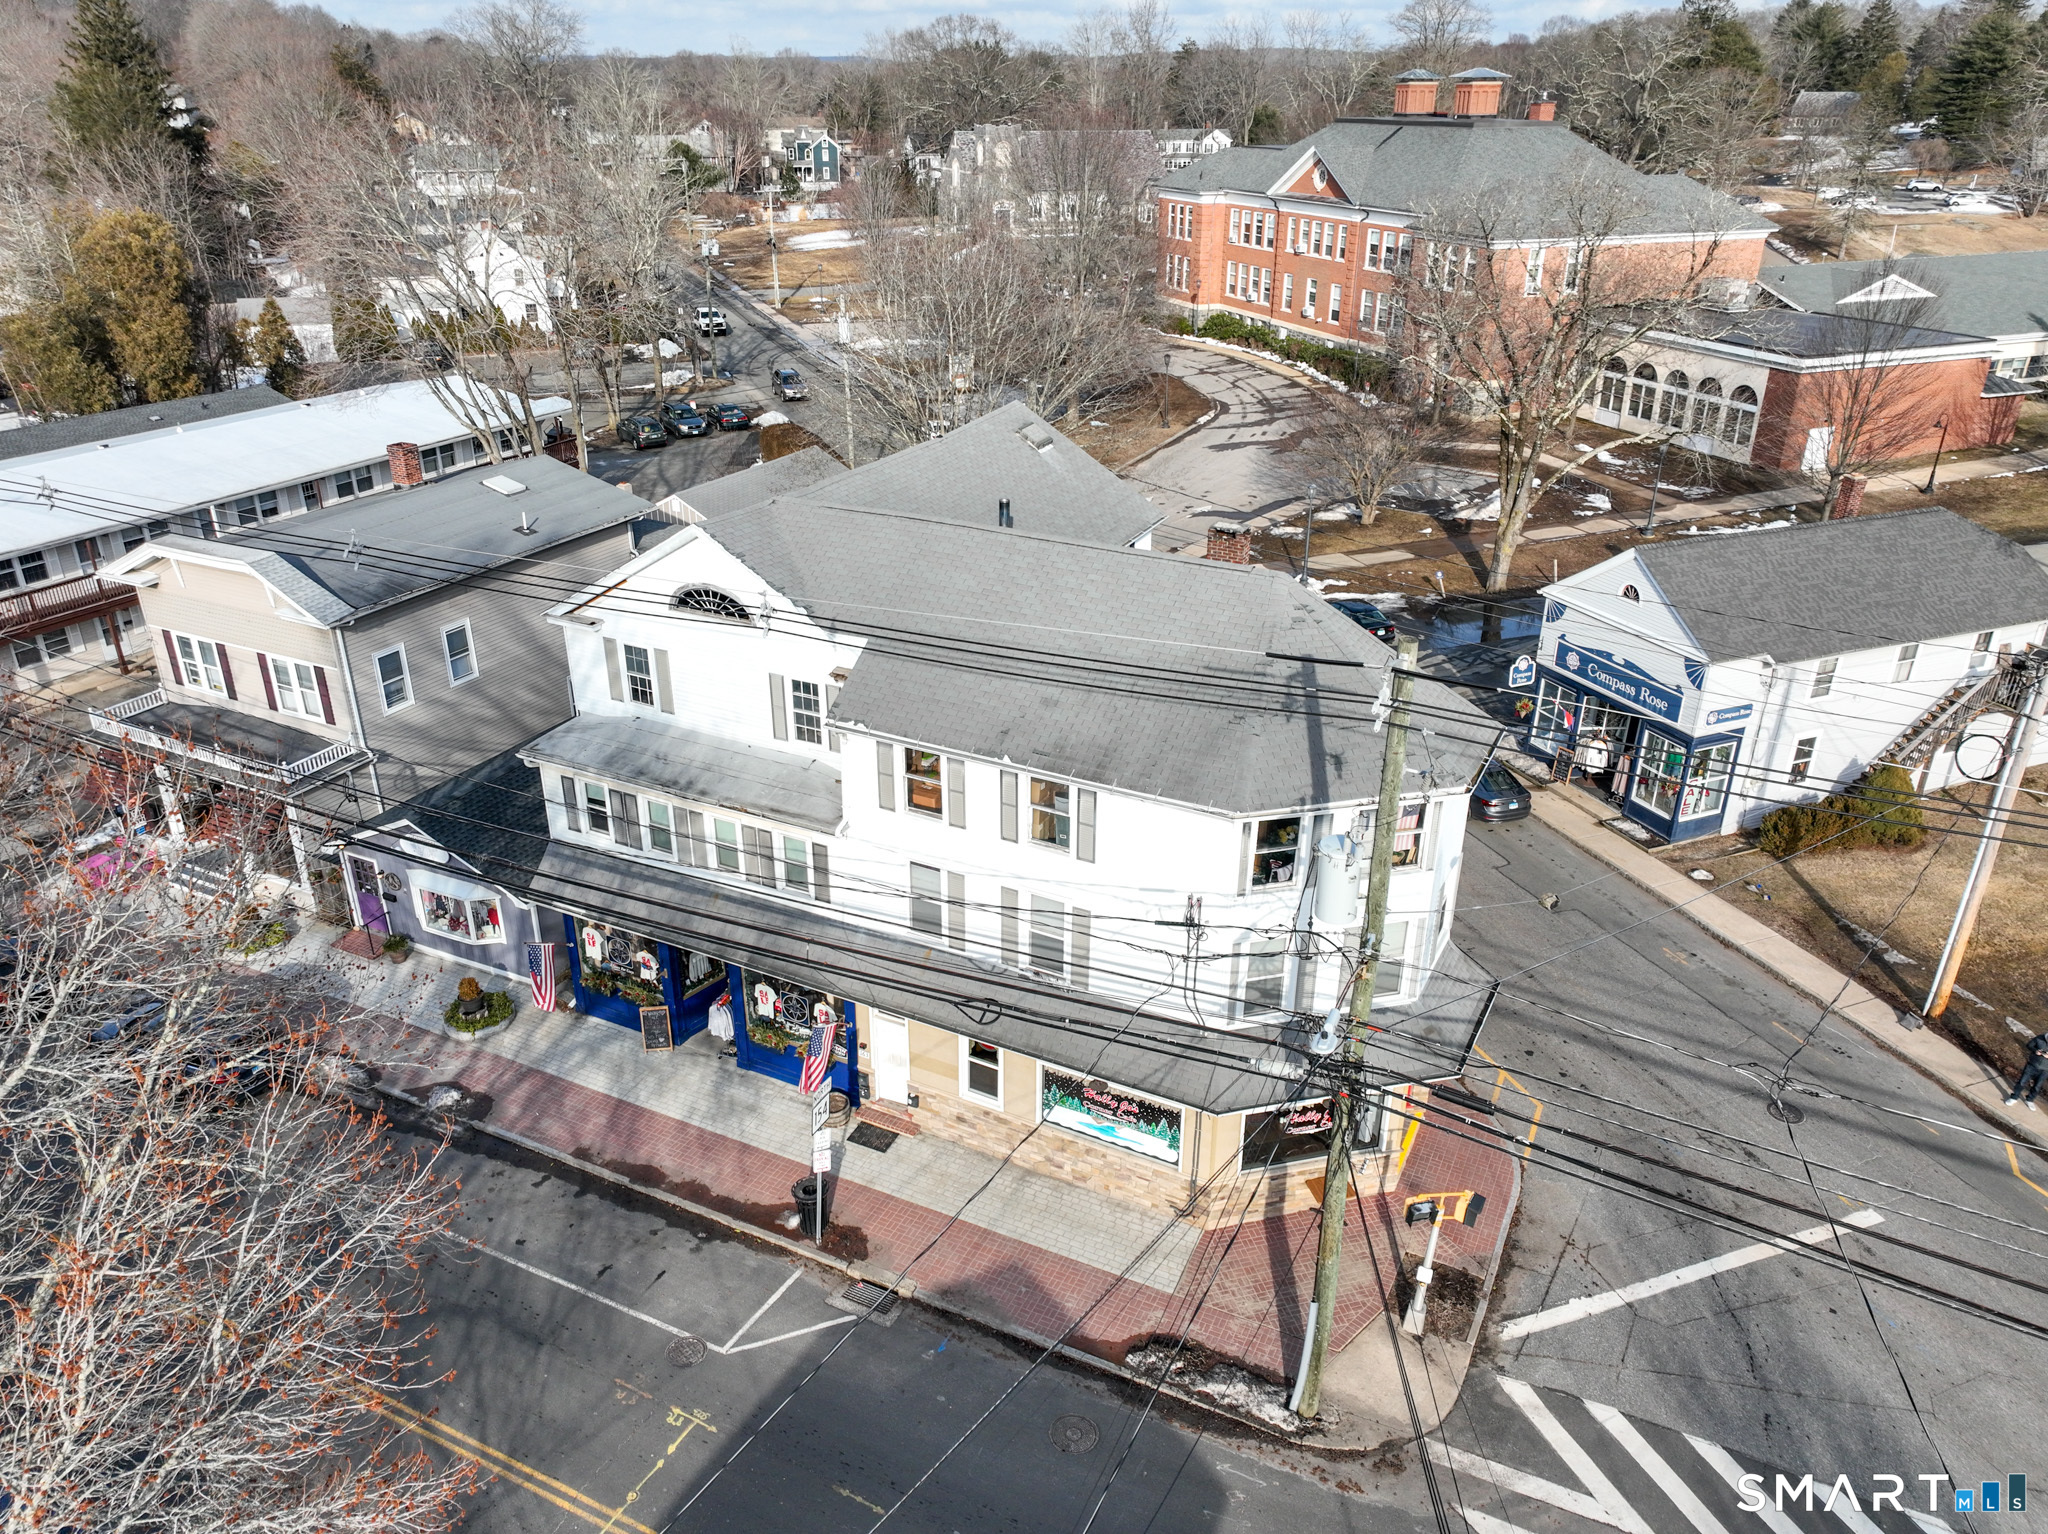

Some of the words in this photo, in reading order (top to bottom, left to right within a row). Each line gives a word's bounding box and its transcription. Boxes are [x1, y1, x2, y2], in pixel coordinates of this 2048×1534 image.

[1587, 663, 1636, 696] Compass
[1639, 687, 1669, 711] Rose
[1718, 712, 1740, 720] Compass
[813, 1080, 831, 1102] NORTH
[814, 1100, 828, 1126] 154
